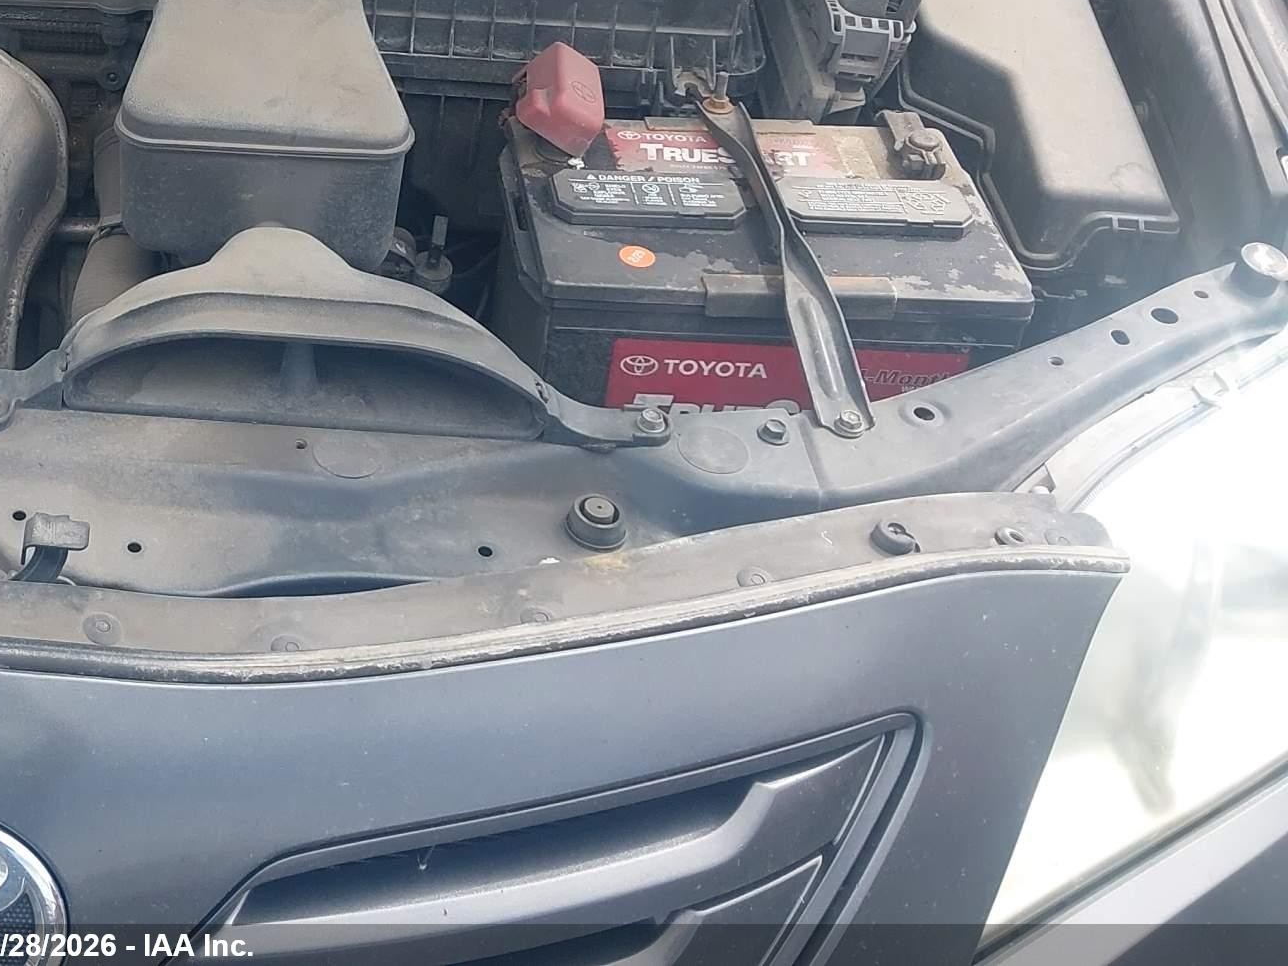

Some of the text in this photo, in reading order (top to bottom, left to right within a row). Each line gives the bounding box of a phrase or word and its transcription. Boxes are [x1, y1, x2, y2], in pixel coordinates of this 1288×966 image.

[644, 130, 707, 143] TOYOTA
[598, 174, 646, 182] DANGER
[664, 359, 767, 379] TOYOTA
